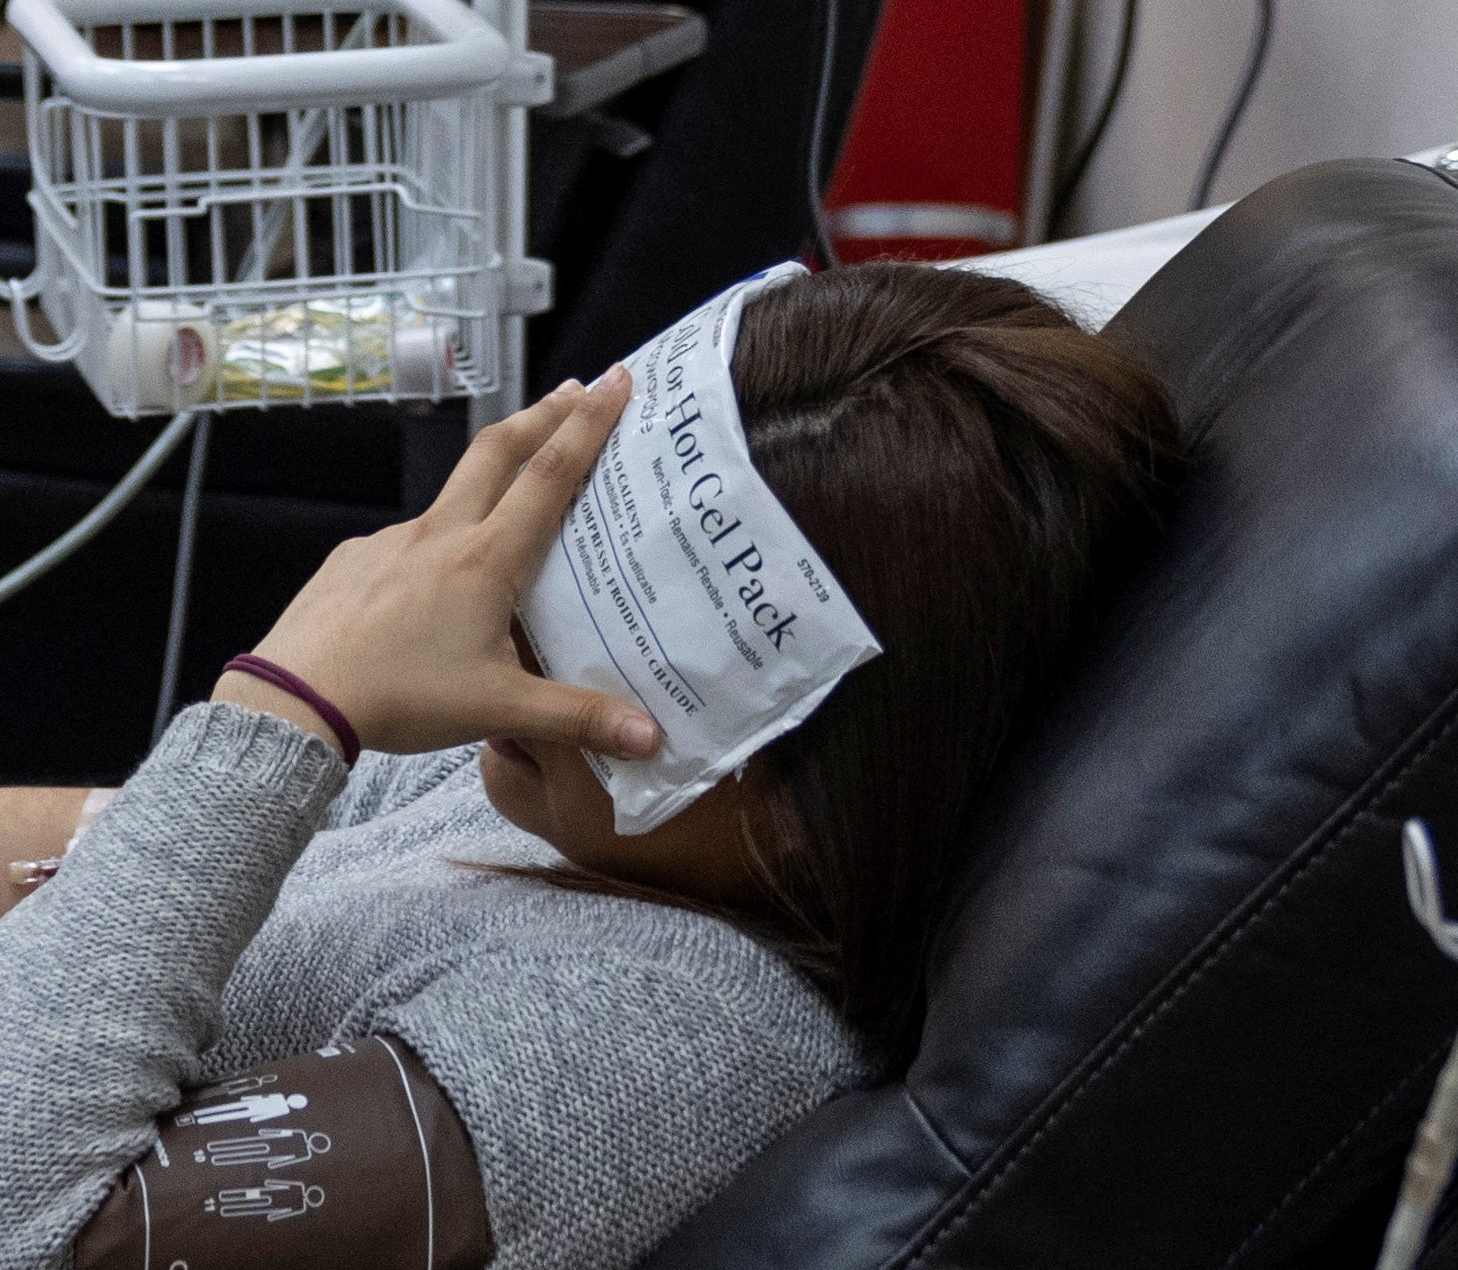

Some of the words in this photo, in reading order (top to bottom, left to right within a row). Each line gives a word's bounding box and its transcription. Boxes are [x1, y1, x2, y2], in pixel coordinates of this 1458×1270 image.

[665, 365, 684, 393] or
[614, 461, 624, 472] O
[665, 391, 704, 475] Hot
[617, 473, 644, 542] CALIENTE
[689, 472, 742, 549] Gel
[625, 546, 657, 604] reutilizable
[651, 456, 674, 510] Non-Toxic
[669, 516, 700, 568] Remains
[696, 565, 724, 610] Flexible
[724, 619, 764, 671] Reusable
[722, 538, 798, 654] Pack
[797, 558, 830, 603] 570-2139
[580, 493, 611, 577] COMPRESSE
[606, 576, 640, 636] FROIDE
[635, 634, 653, 658] OU
[648, 658, 698, 717] CHAUDE
